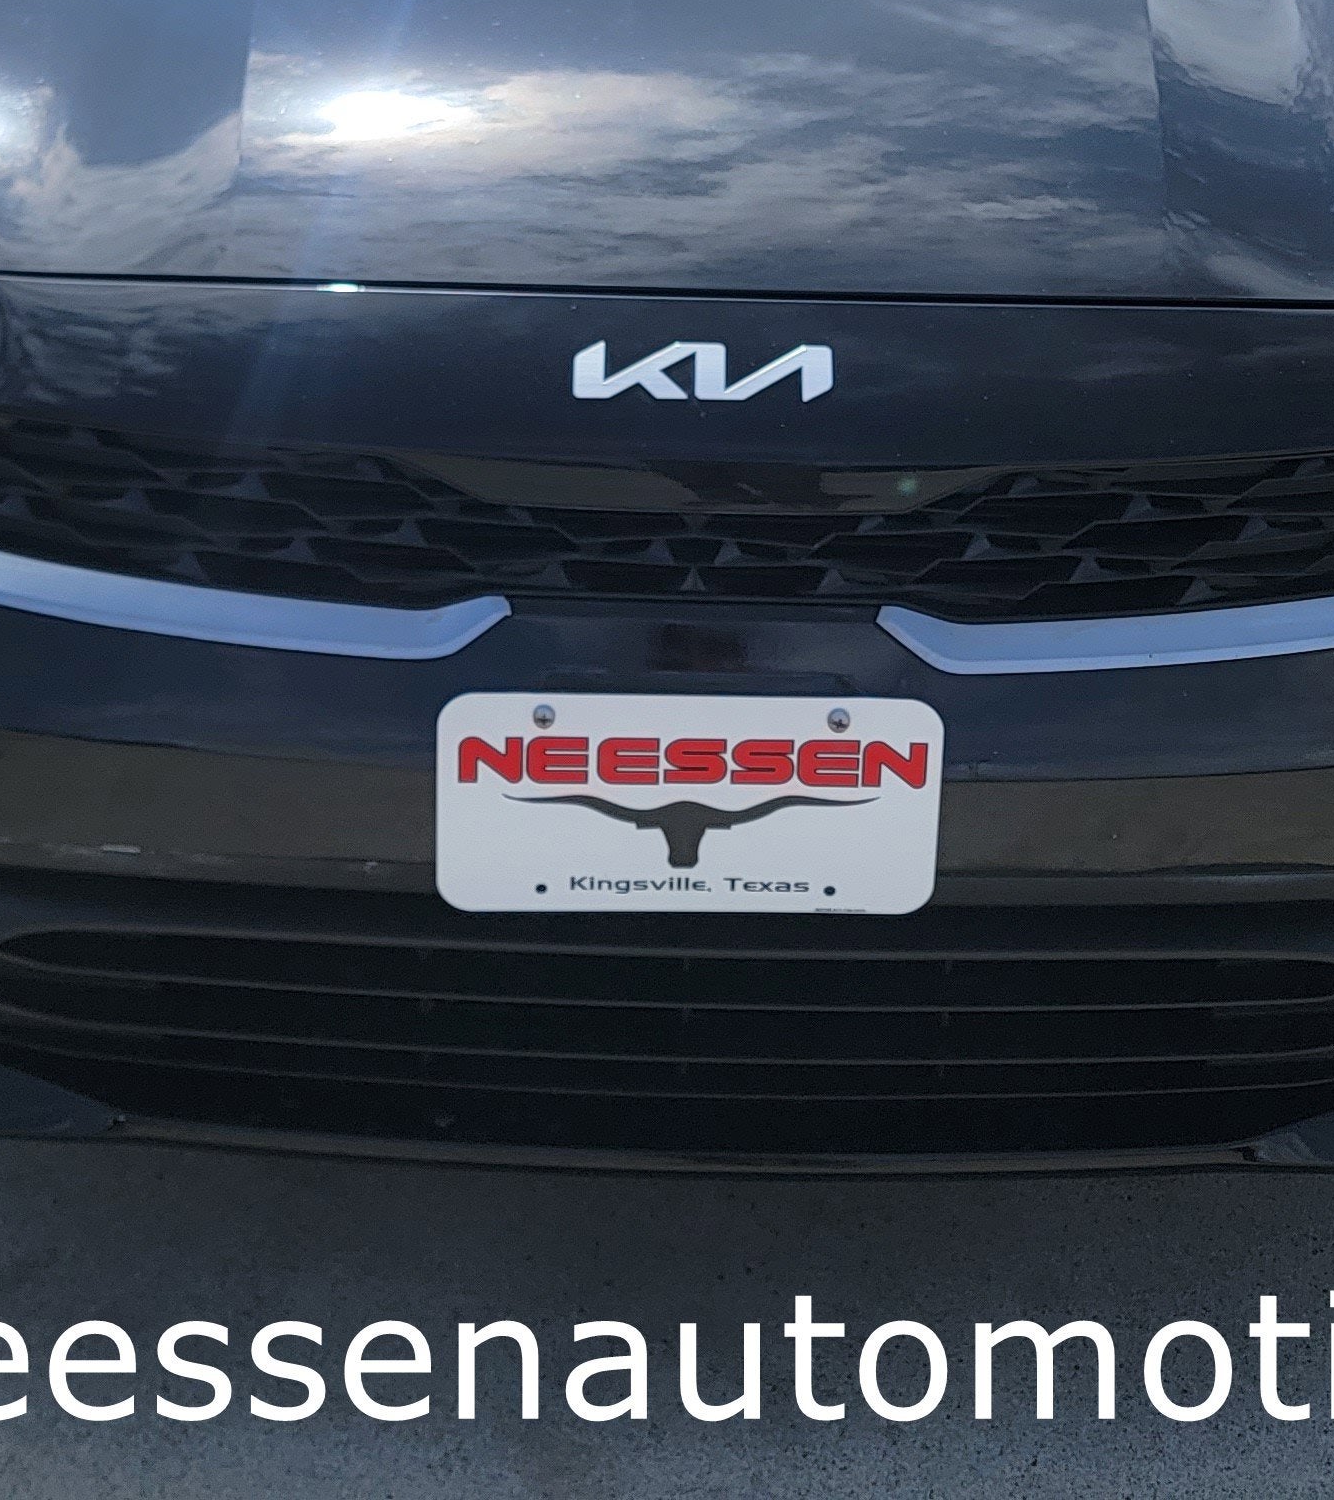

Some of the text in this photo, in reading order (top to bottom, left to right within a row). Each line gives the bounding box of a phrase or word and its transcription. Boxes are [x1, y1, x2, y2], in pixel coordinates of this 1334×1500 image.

[572, 339, 834, 403] KIA
[458, 736, 929, 789] NEESSEN
[722, 877, 811, 894] Texas
